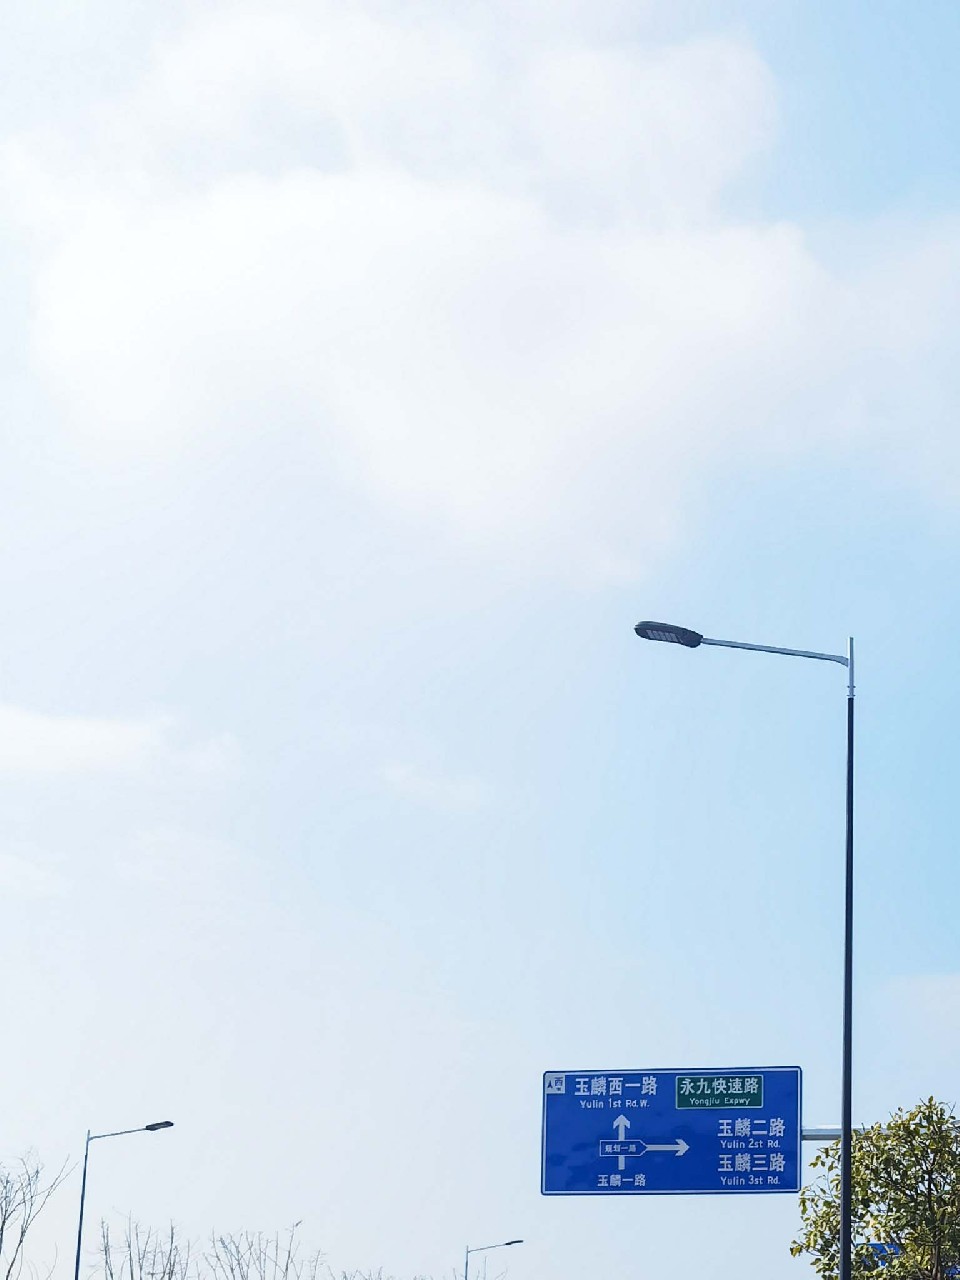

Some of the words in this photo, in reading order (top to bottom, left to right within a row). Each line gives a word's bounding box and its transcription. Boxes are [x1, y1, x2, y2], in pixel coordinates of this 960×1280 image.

[574, 1075, 658, 1096] 玉麟西一路
[680, 1077, 759, 1095] 永九快速路
[580, 1100, 604, 1109] Yulin
[608, 1098, 622, 1108] 1st
[689, 1097, 720, 1107] Yongjiu
[724, 1097, 751, 1106] Expwy
[717, 1117, 786, 1138] 玉麟二路
[720, 1140, 746, 1149] Yulin
[767, 1139, 781, 1148] Rd.
[717, 1152, 787, 1172] 玉麟三路
[597, 1173, 646, 1187] 玉麟一路
[720, 1176, 746, 1186] Yulin
[767, 1175, 781, 1185] Rd.
